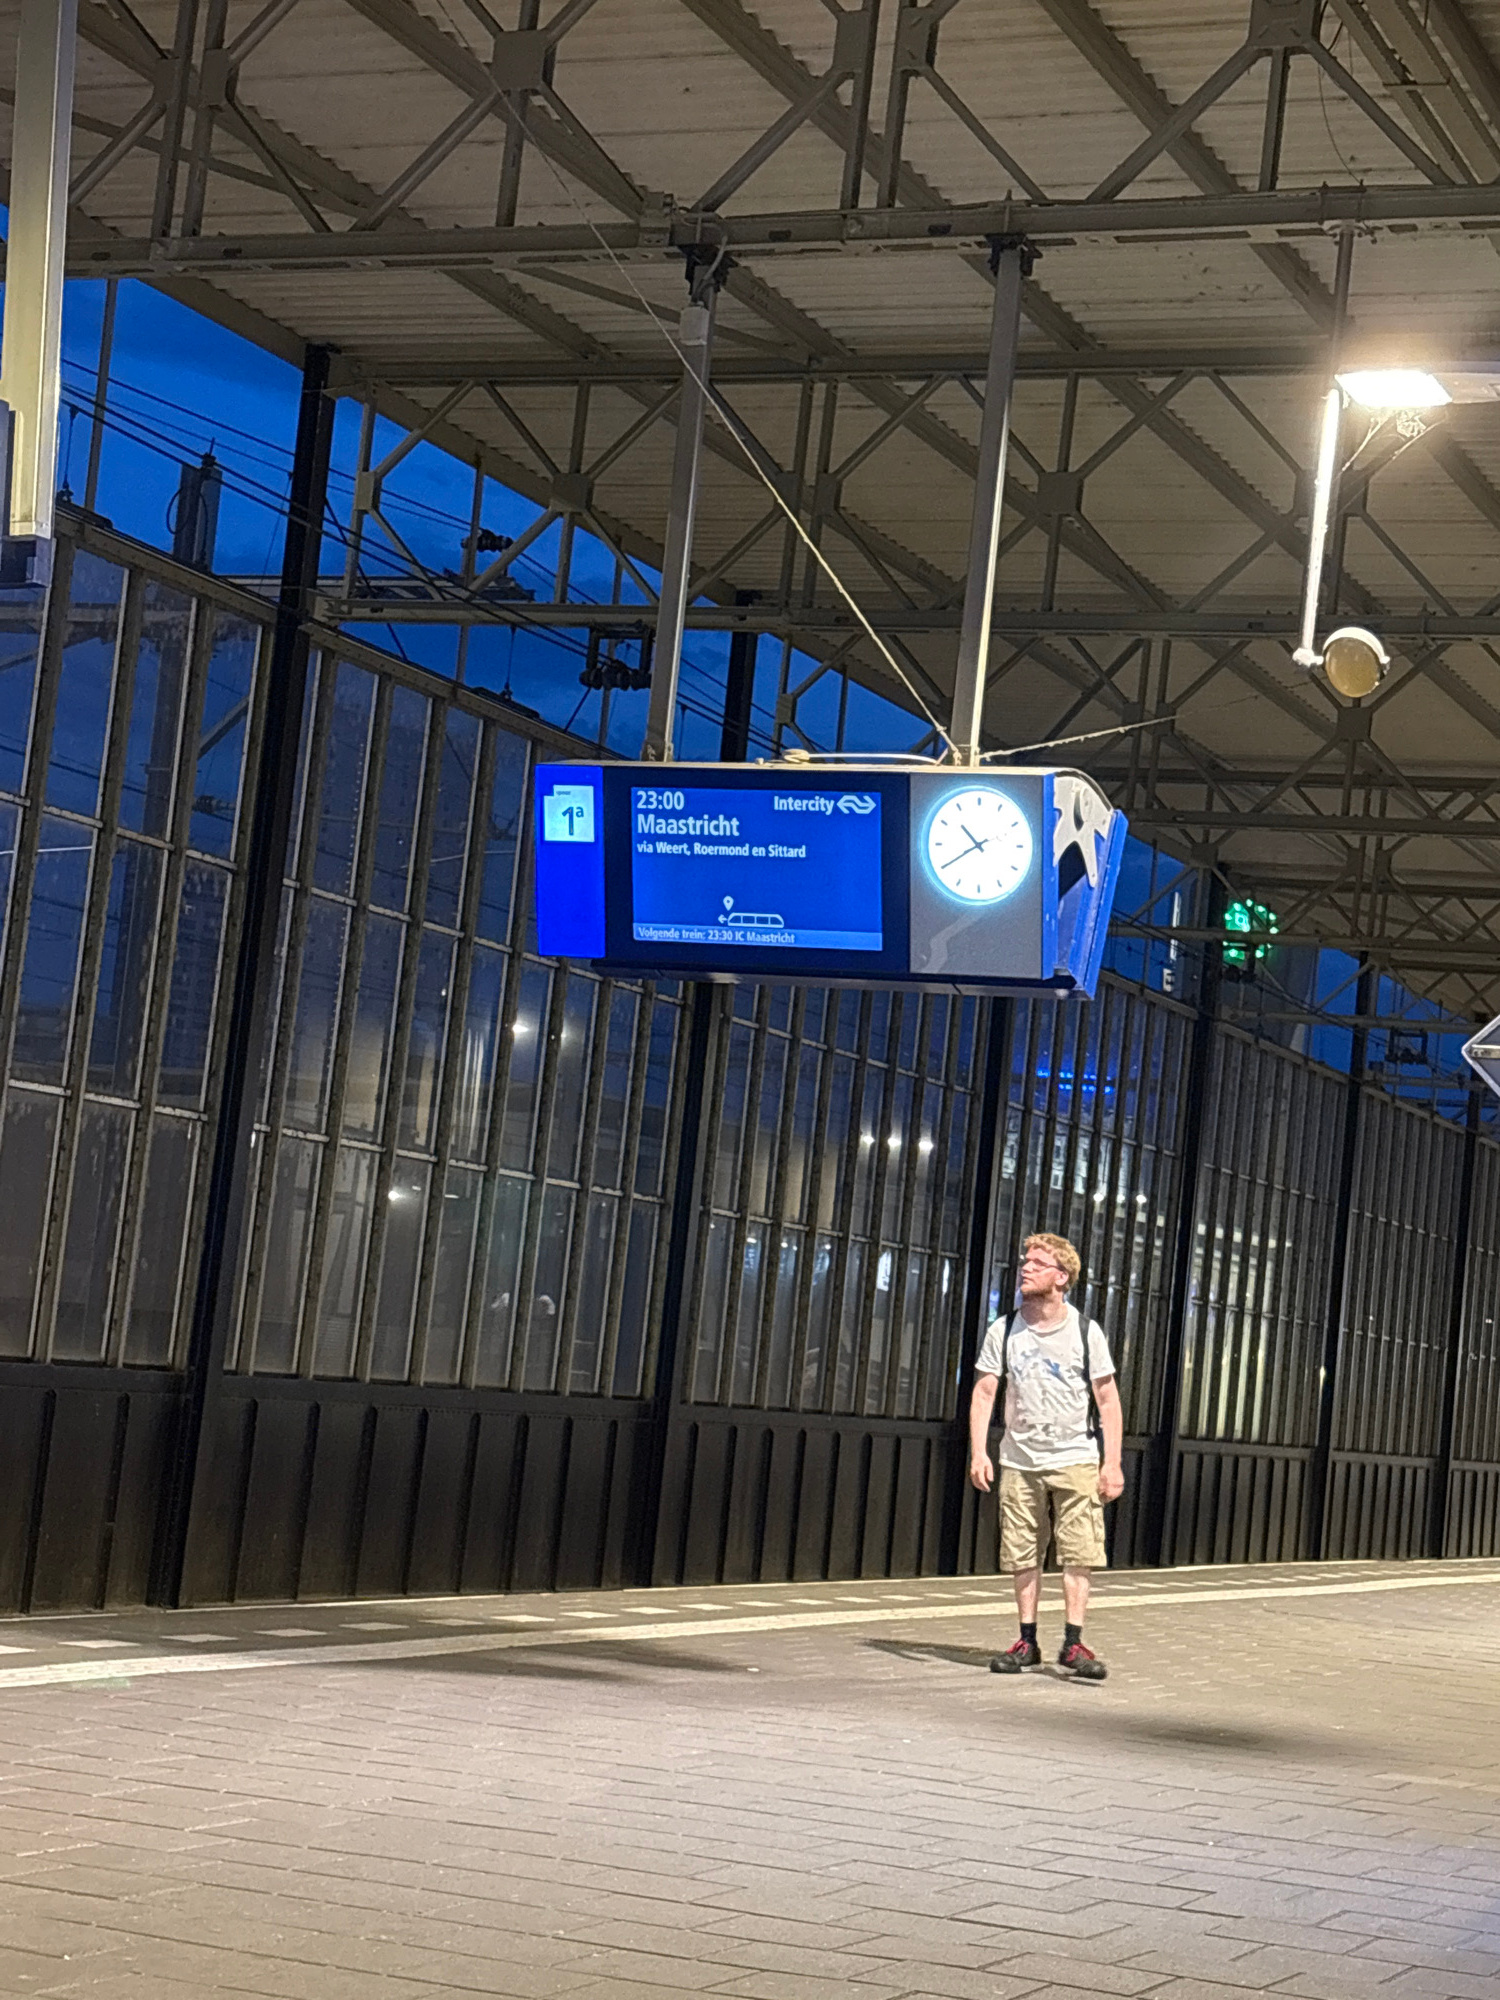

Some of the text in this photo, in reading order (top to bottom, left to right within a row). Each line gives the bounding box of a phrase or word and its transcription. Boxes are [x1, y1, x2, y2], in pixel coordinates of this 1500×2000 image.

[636, 790, 685, 810] 23:00
[773, 795, 835, 816] Intercity
[637, 813, 740, 837] Maastricht
[636, 840, 806, 858] via Weert, Roermond en Sittard
[638, 927, 795, 944] Volgende trein: 23:30 IC Maastricht
